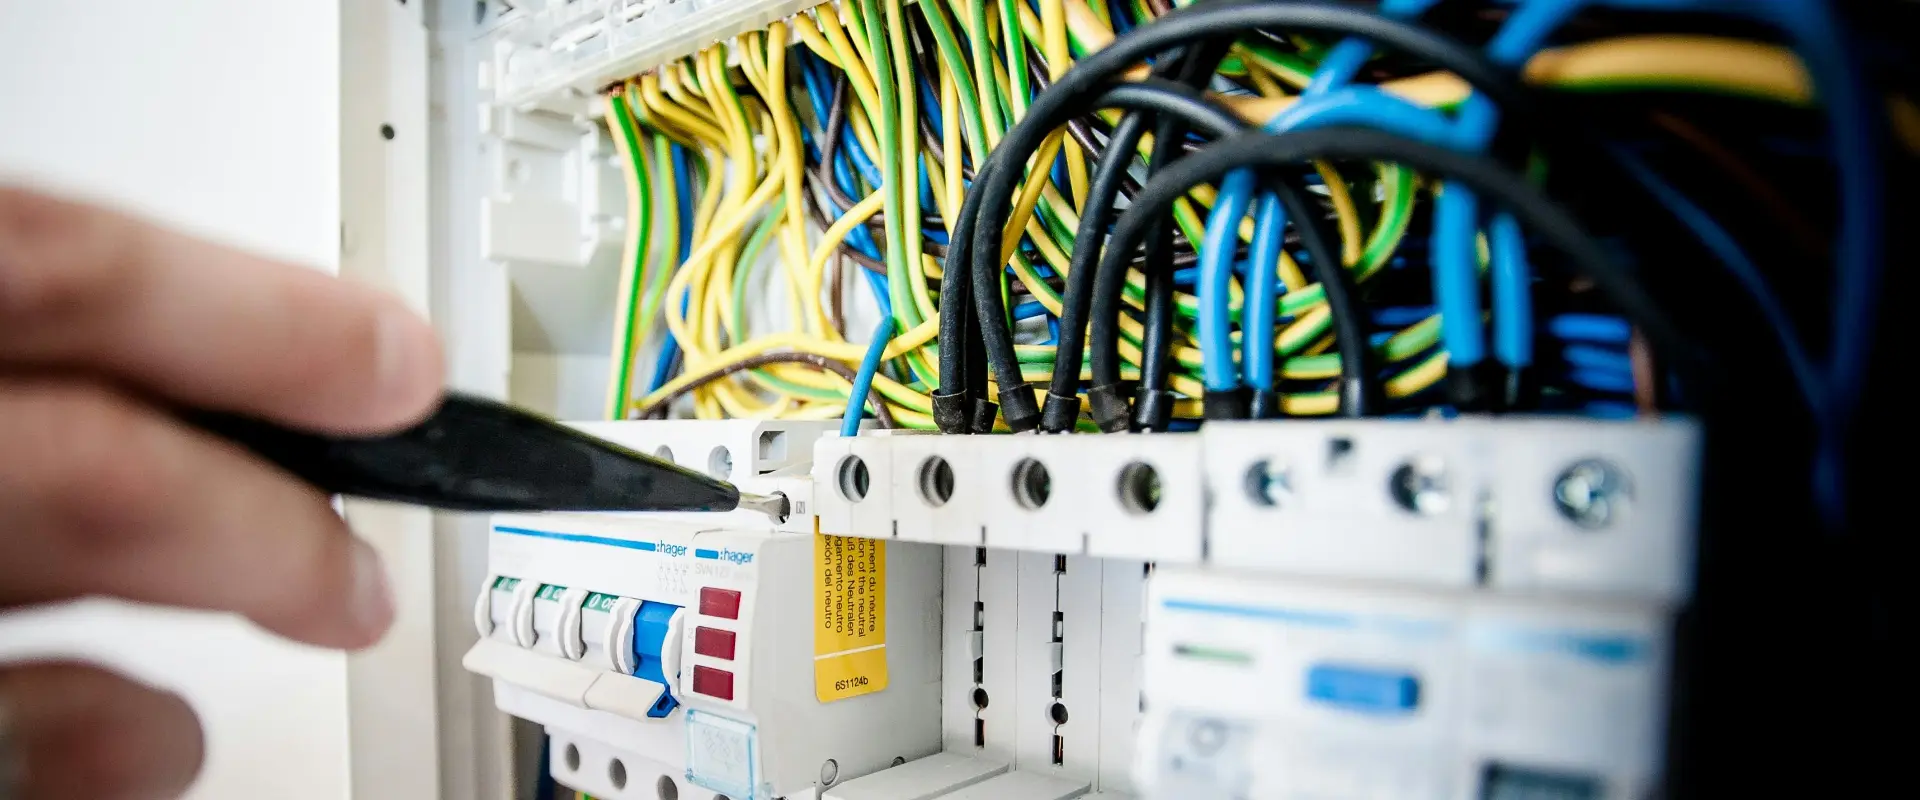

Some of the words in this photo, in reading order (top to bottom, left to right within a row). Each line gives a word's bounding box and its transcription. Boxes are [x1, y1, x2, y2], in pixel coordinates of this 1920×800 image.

[847, 554, 855, 577] des
[858, 561, 866, 573] of
[858, 576, 866, 595] the
[869, 576, 876, 592] du
[847, 580, 855, 637] Neutralen
[858, 598, 866, 638] neutral
[835, 675, 869, 691] 6S1124b
